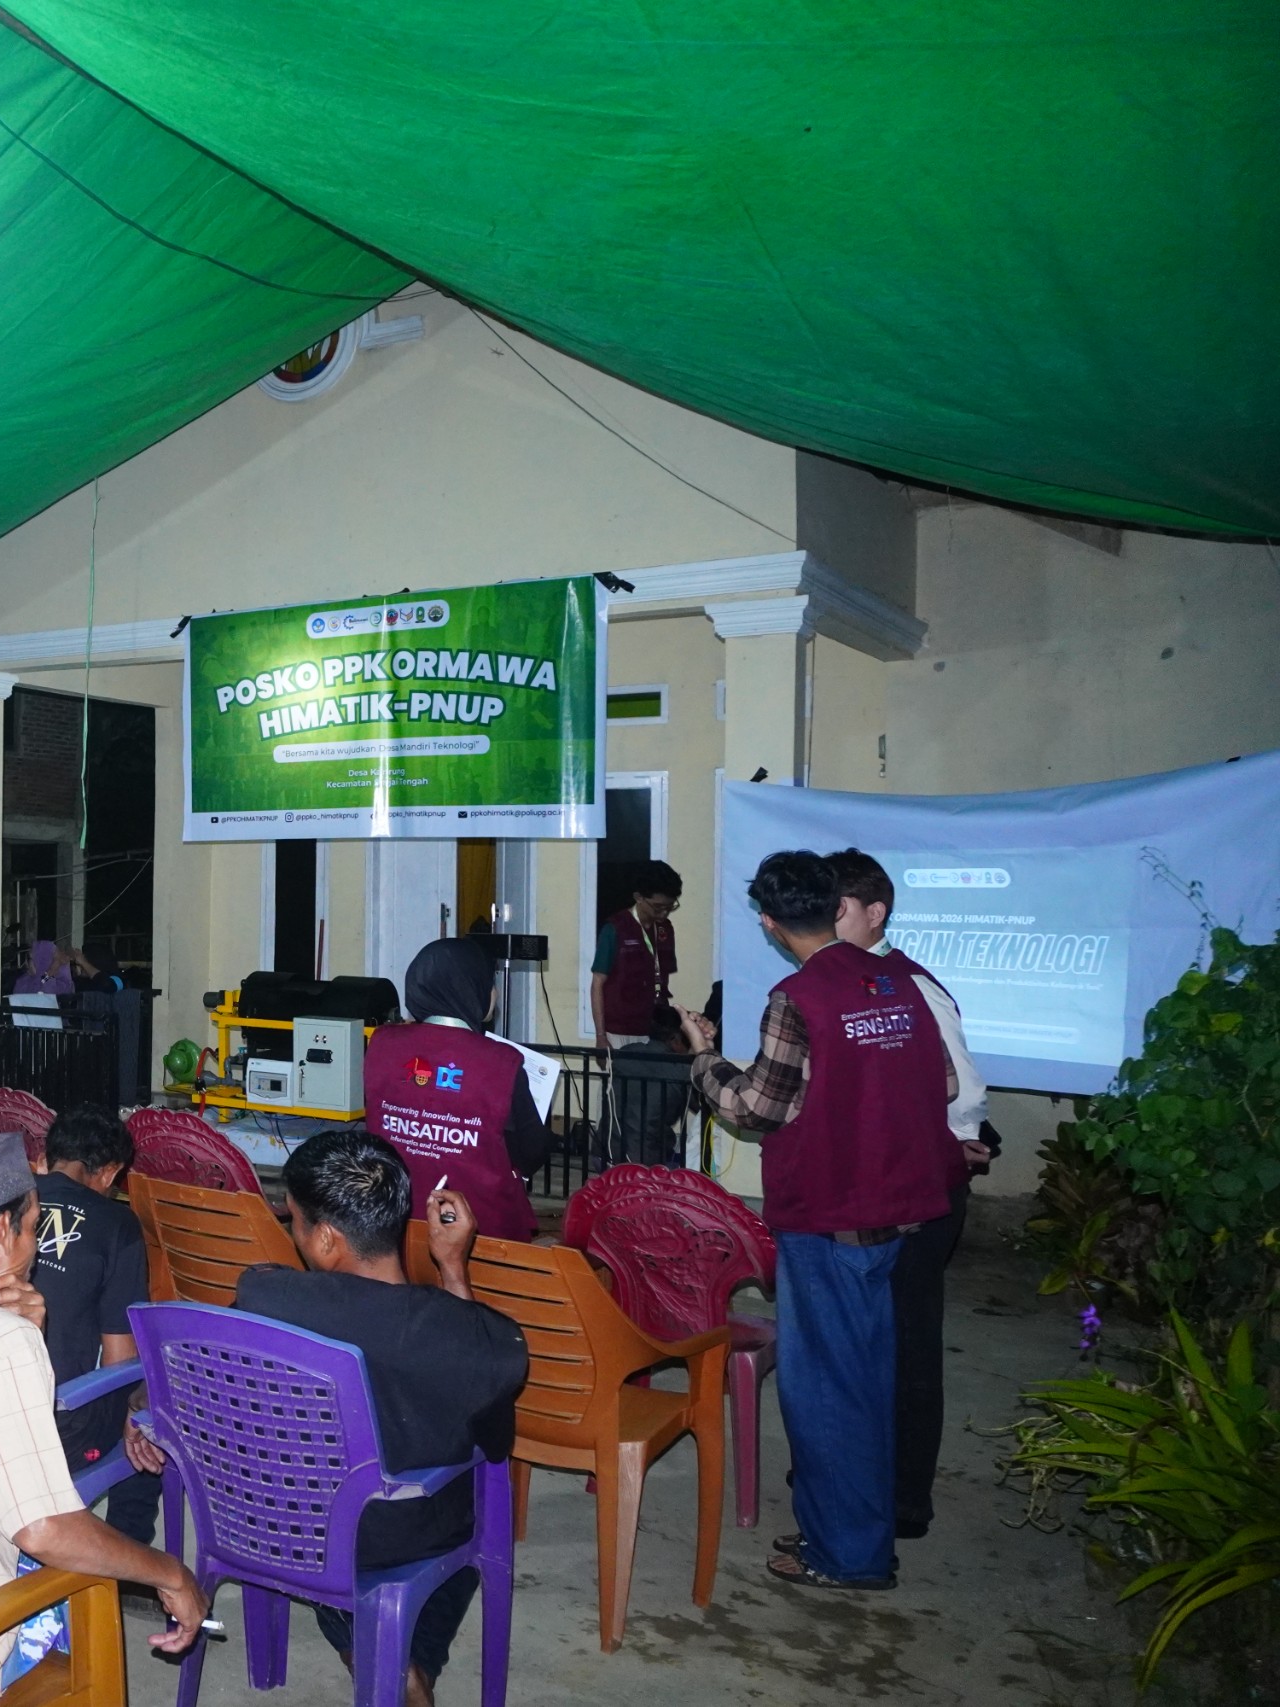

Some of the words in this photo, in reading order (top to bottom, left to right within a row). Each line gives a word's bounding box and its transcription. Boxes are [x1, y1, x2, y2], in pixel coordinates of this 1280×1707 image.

[216, 662, 320, 713] POSKO
[323, 651, 388, 687] PPK
[391, 650, 557, 692] ORMAWA
[259, 692, 505, 739] HIMATIK-PNUP
[321, 747, 335, 757] kita
[337, 745, 377, 756] wujudkan
[400, 742, 431, 752] Mandiri
[348, 768, 368, 777] Desa
[326, 779, 372, 788] Kecamatan
[894, 912, 939, 923] ORMAWA
[940, 913, 963, 923] 2026
[964, 914, 1036, 926] HIMATIK-PNUP
[956, 931, 1110, 976] TEKNOLOGI
[381, 1100, 420, 1118] Empowering
[421, 1109, 461, 1124] Innovation
[463, 1116, 482, 1127] with
[382, 1113, 479, 1147] SENSATION
[390, 1134, 419, 1147] Informatics
[406, 1146, 441, 1159] Engineering
